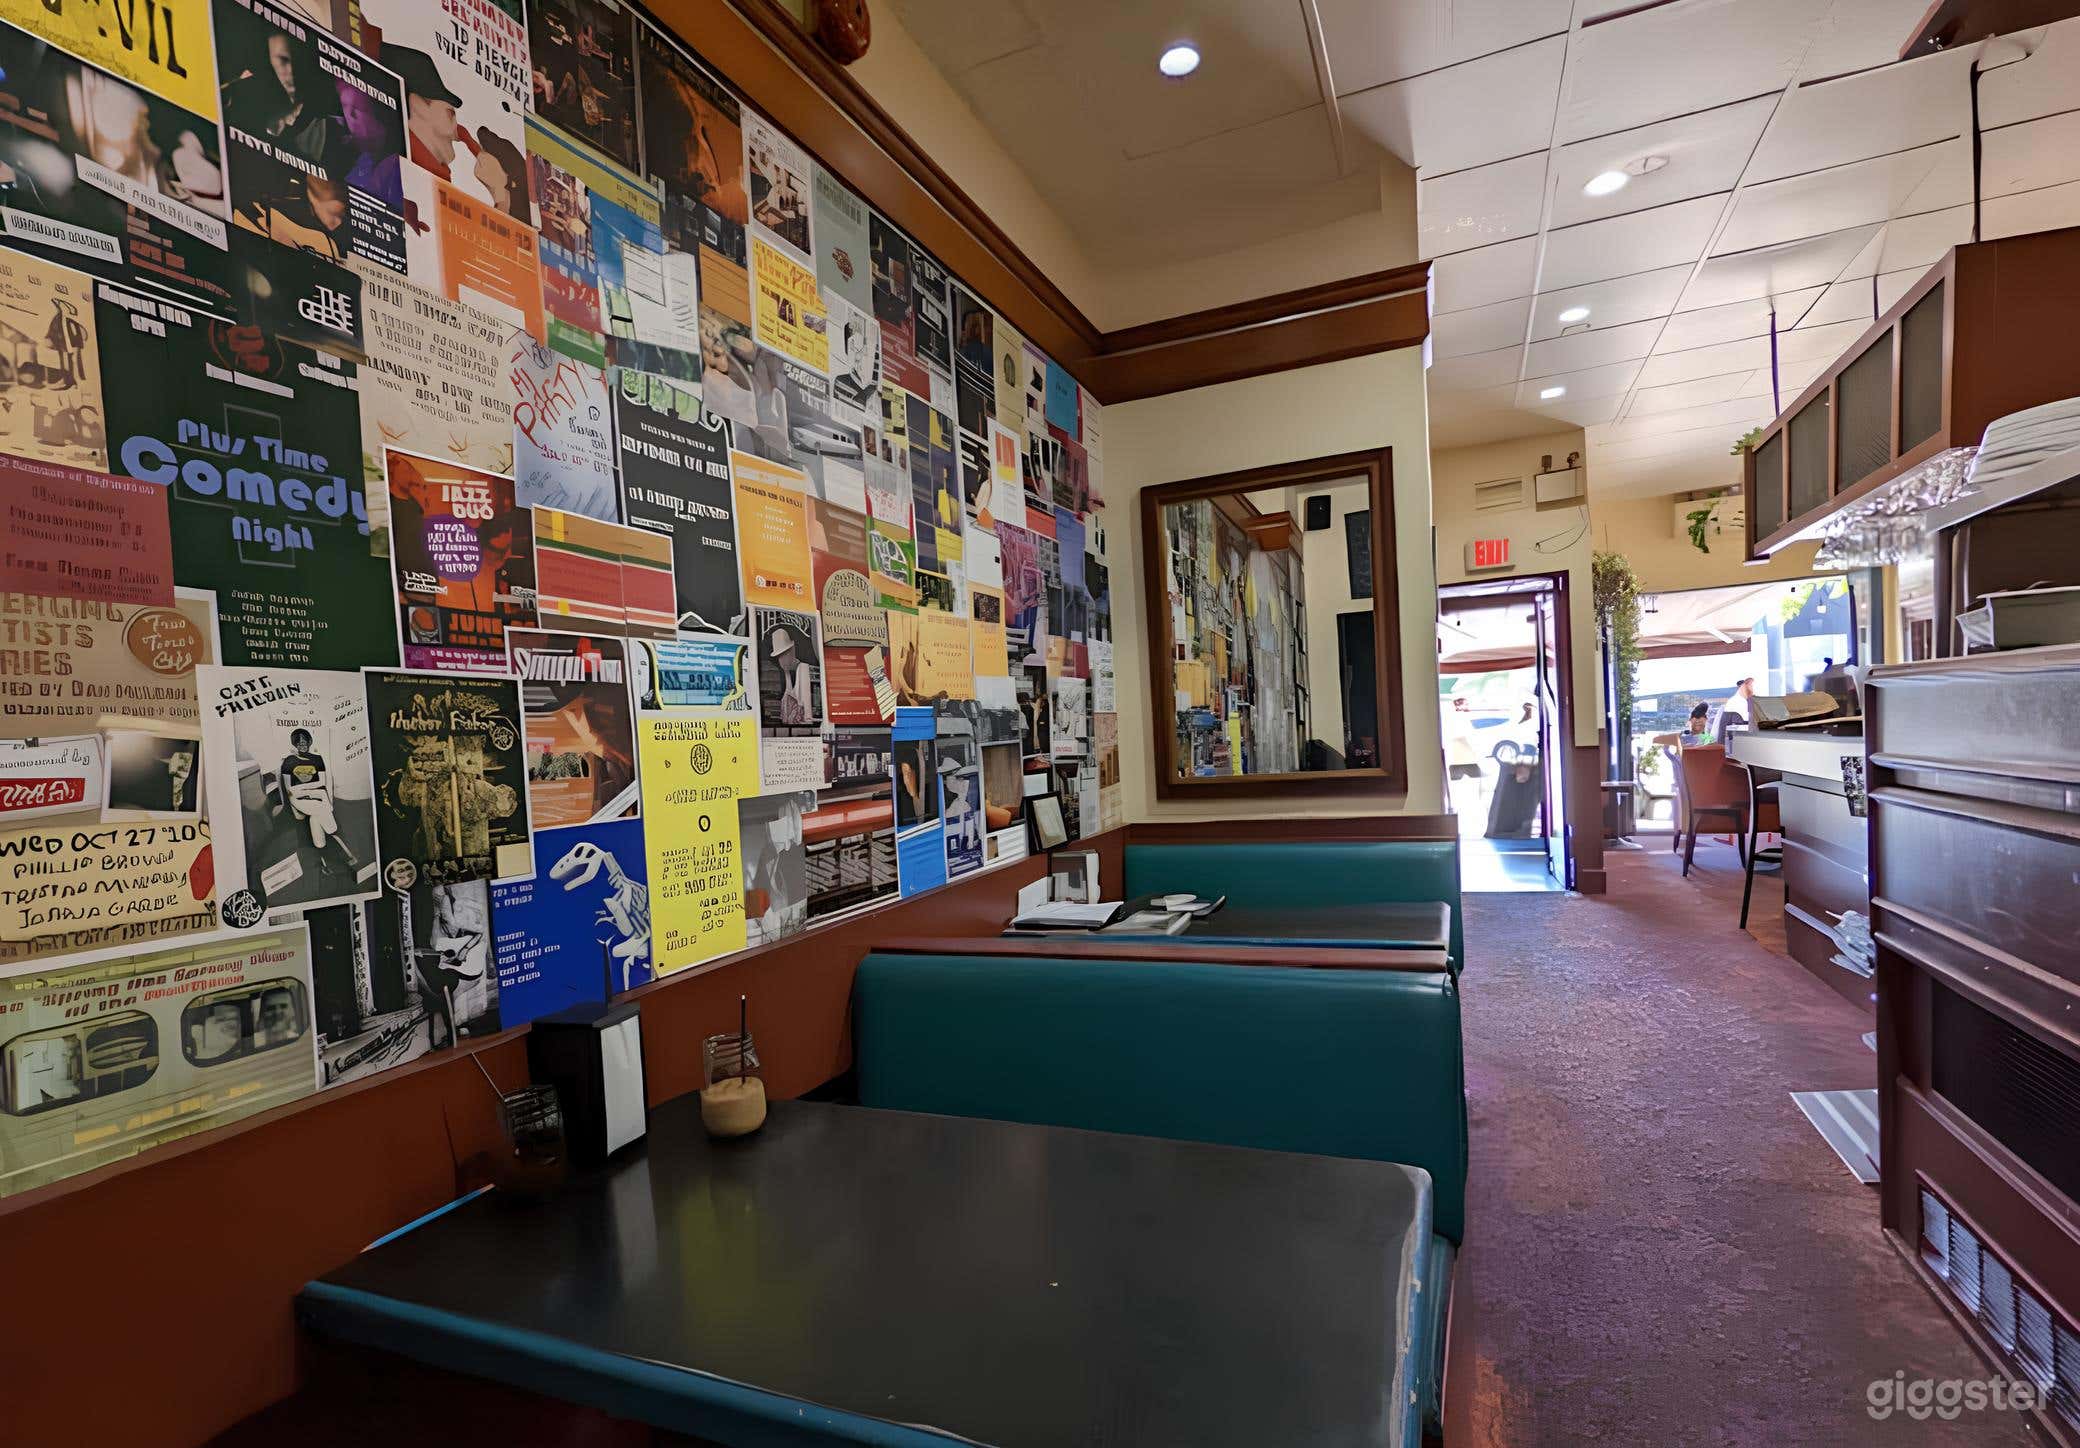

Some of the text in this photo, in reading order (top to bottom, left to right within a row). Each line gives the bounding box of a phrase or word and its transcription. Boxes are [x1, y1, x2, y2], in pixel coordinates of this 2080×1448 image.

[120, 435, 371, 537] Comedy
[1475, 537, 1509, 567] EXIT
[125, 828, 156, 847] 27
